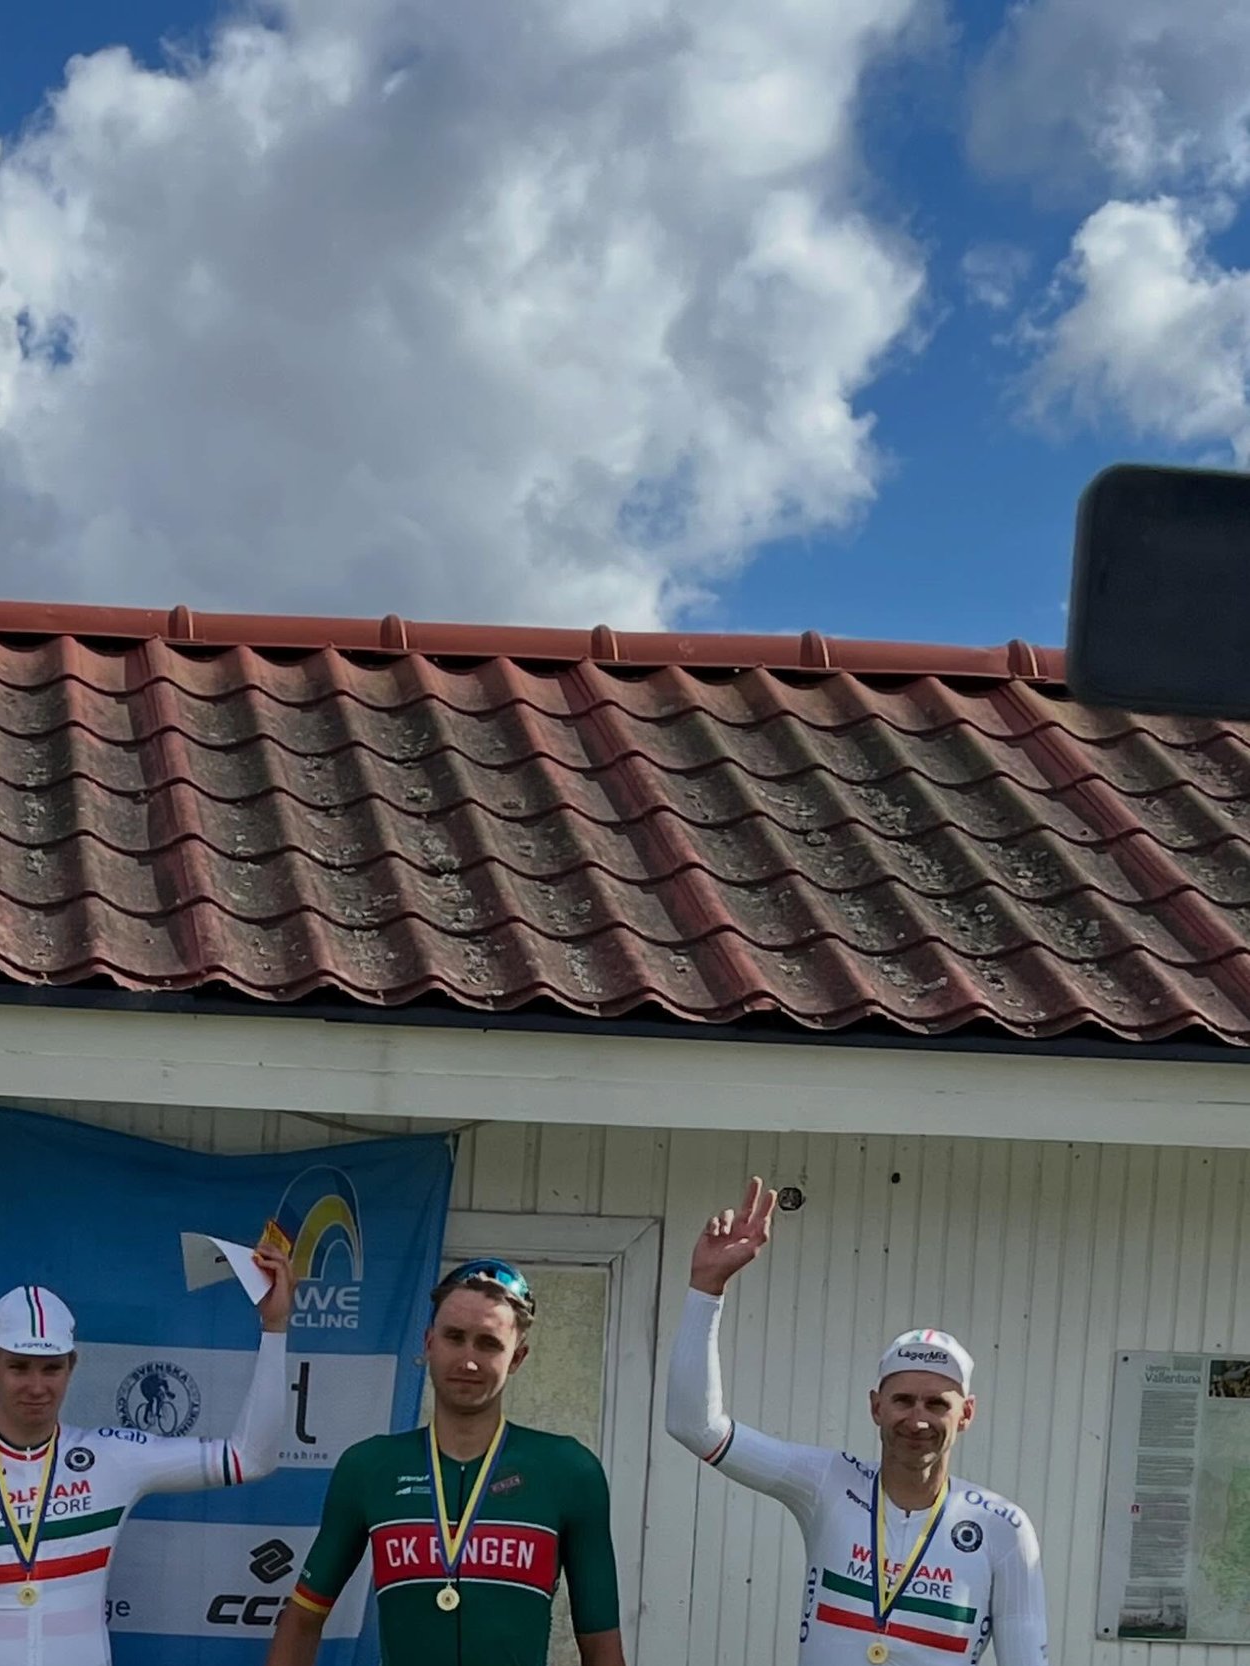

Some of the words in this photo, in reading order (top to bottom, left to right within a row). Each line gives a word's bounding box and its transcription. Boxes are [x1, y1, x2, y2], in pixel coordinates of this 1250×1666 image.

[294, 1287, 361, 1311] WE
[291, 1313, 359, 1329] CLING
[279, 1450, 329, 1461] ershine
[964, 1490, 1023, 1529] Ocab
[385, 1537, 420, 1568] CK
[429, 1536, 535, 1570] RNGEN
[206, 1594, 286, 1625] CC
